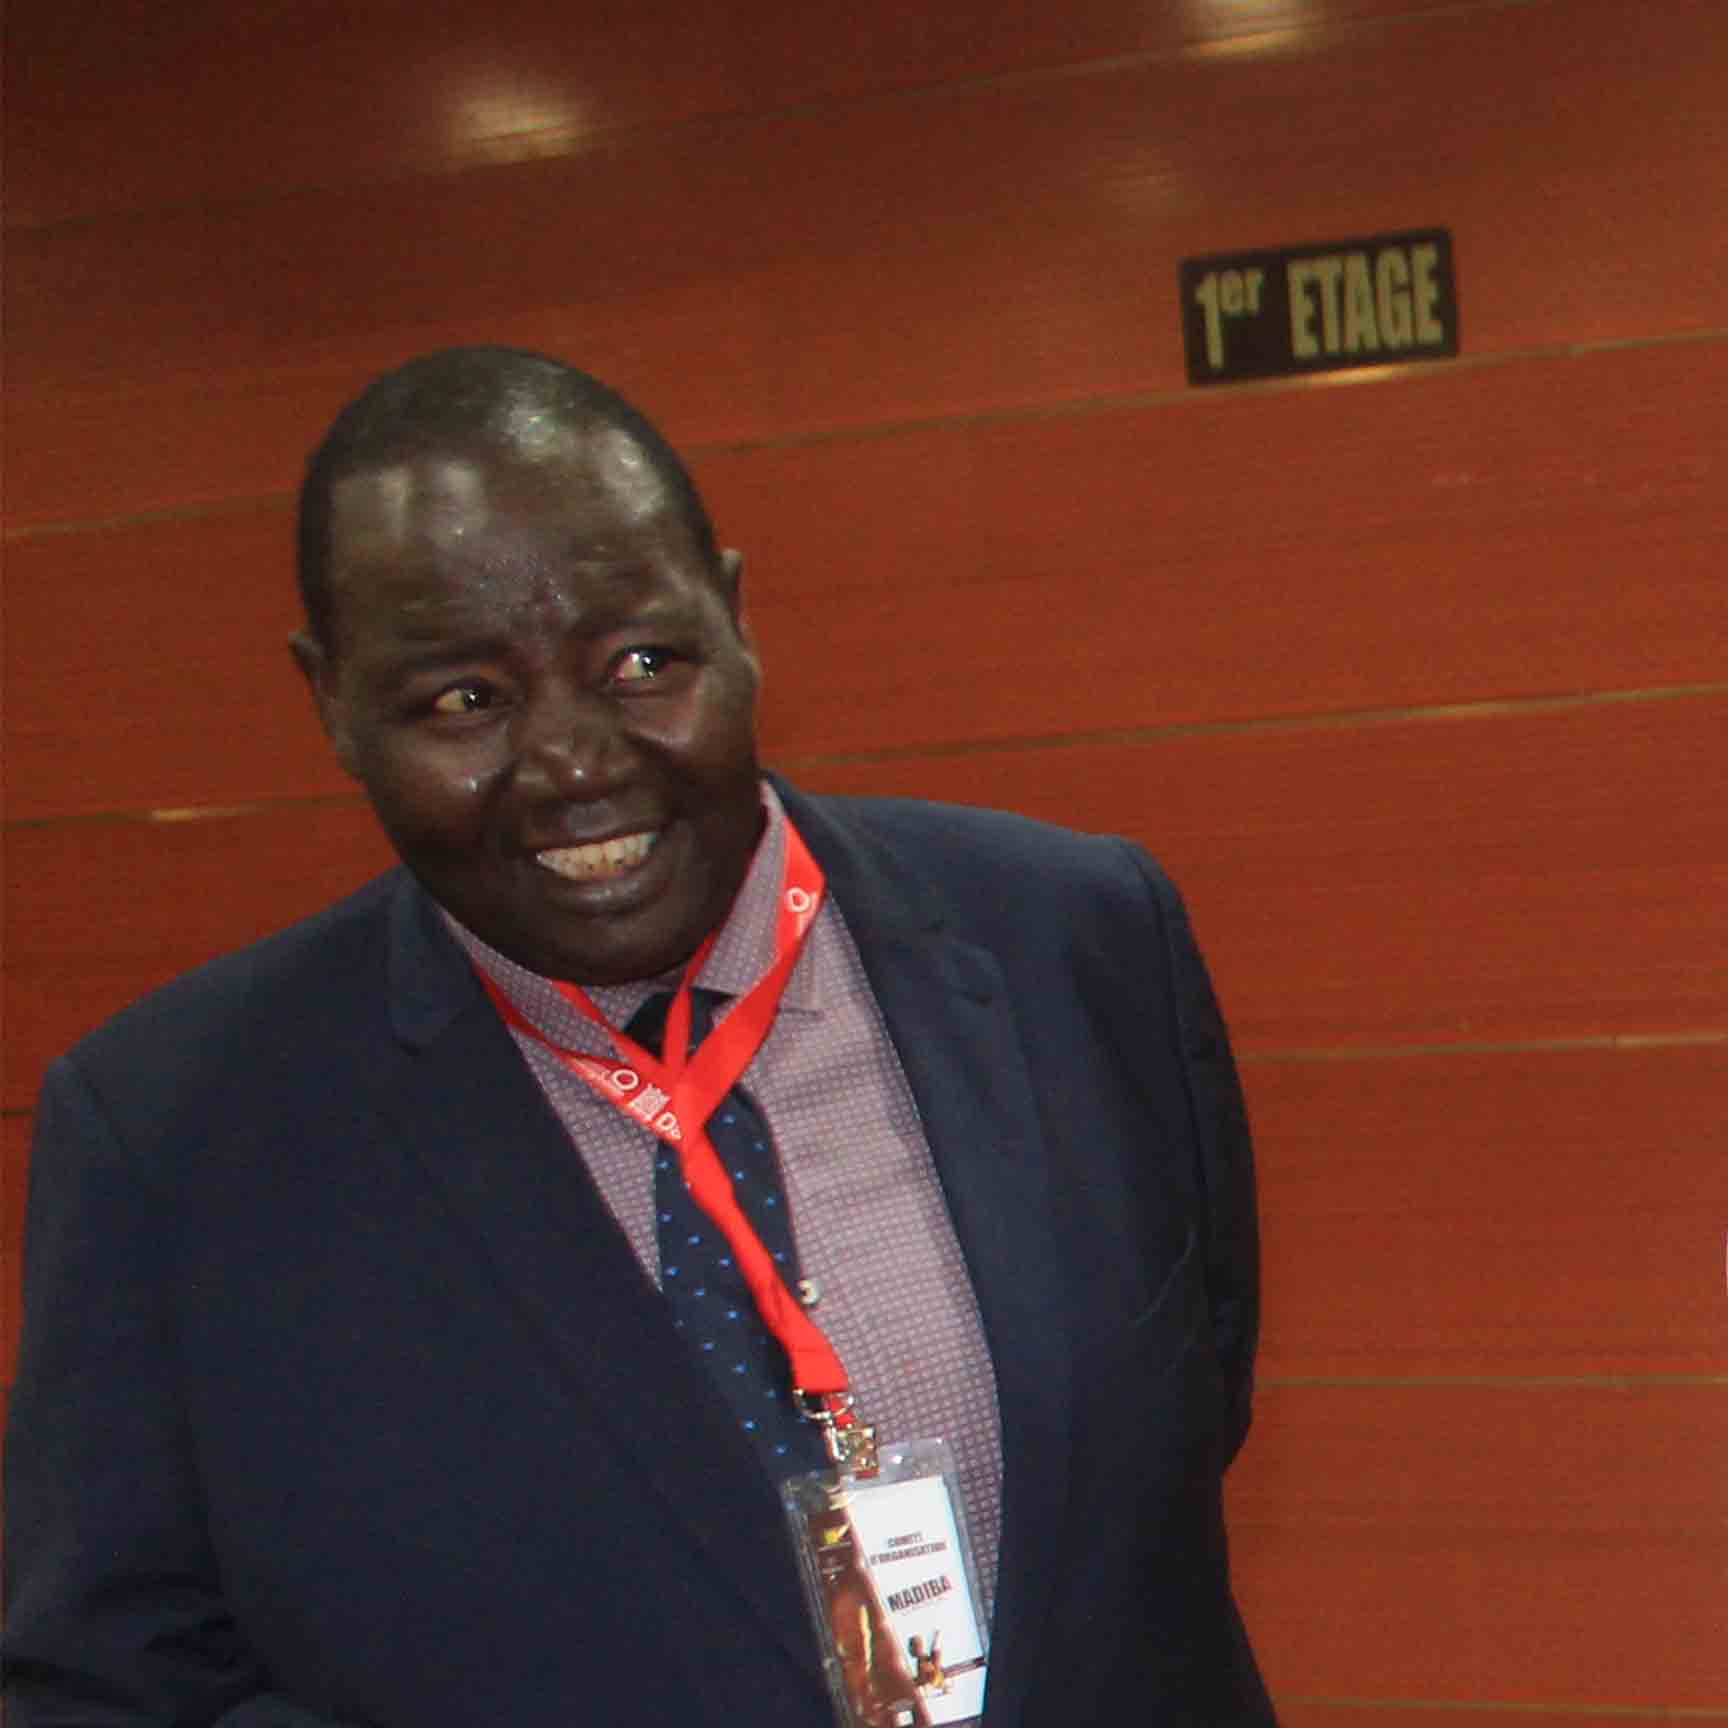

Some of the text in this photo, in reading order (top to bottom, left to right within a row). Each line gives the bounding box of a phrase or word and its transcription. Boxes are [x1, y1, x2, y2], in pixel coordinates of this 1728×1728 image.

[1195, 244, 1443, 369] 1er ETAGE
[887, 1575, 952, 1612] MADIBA
